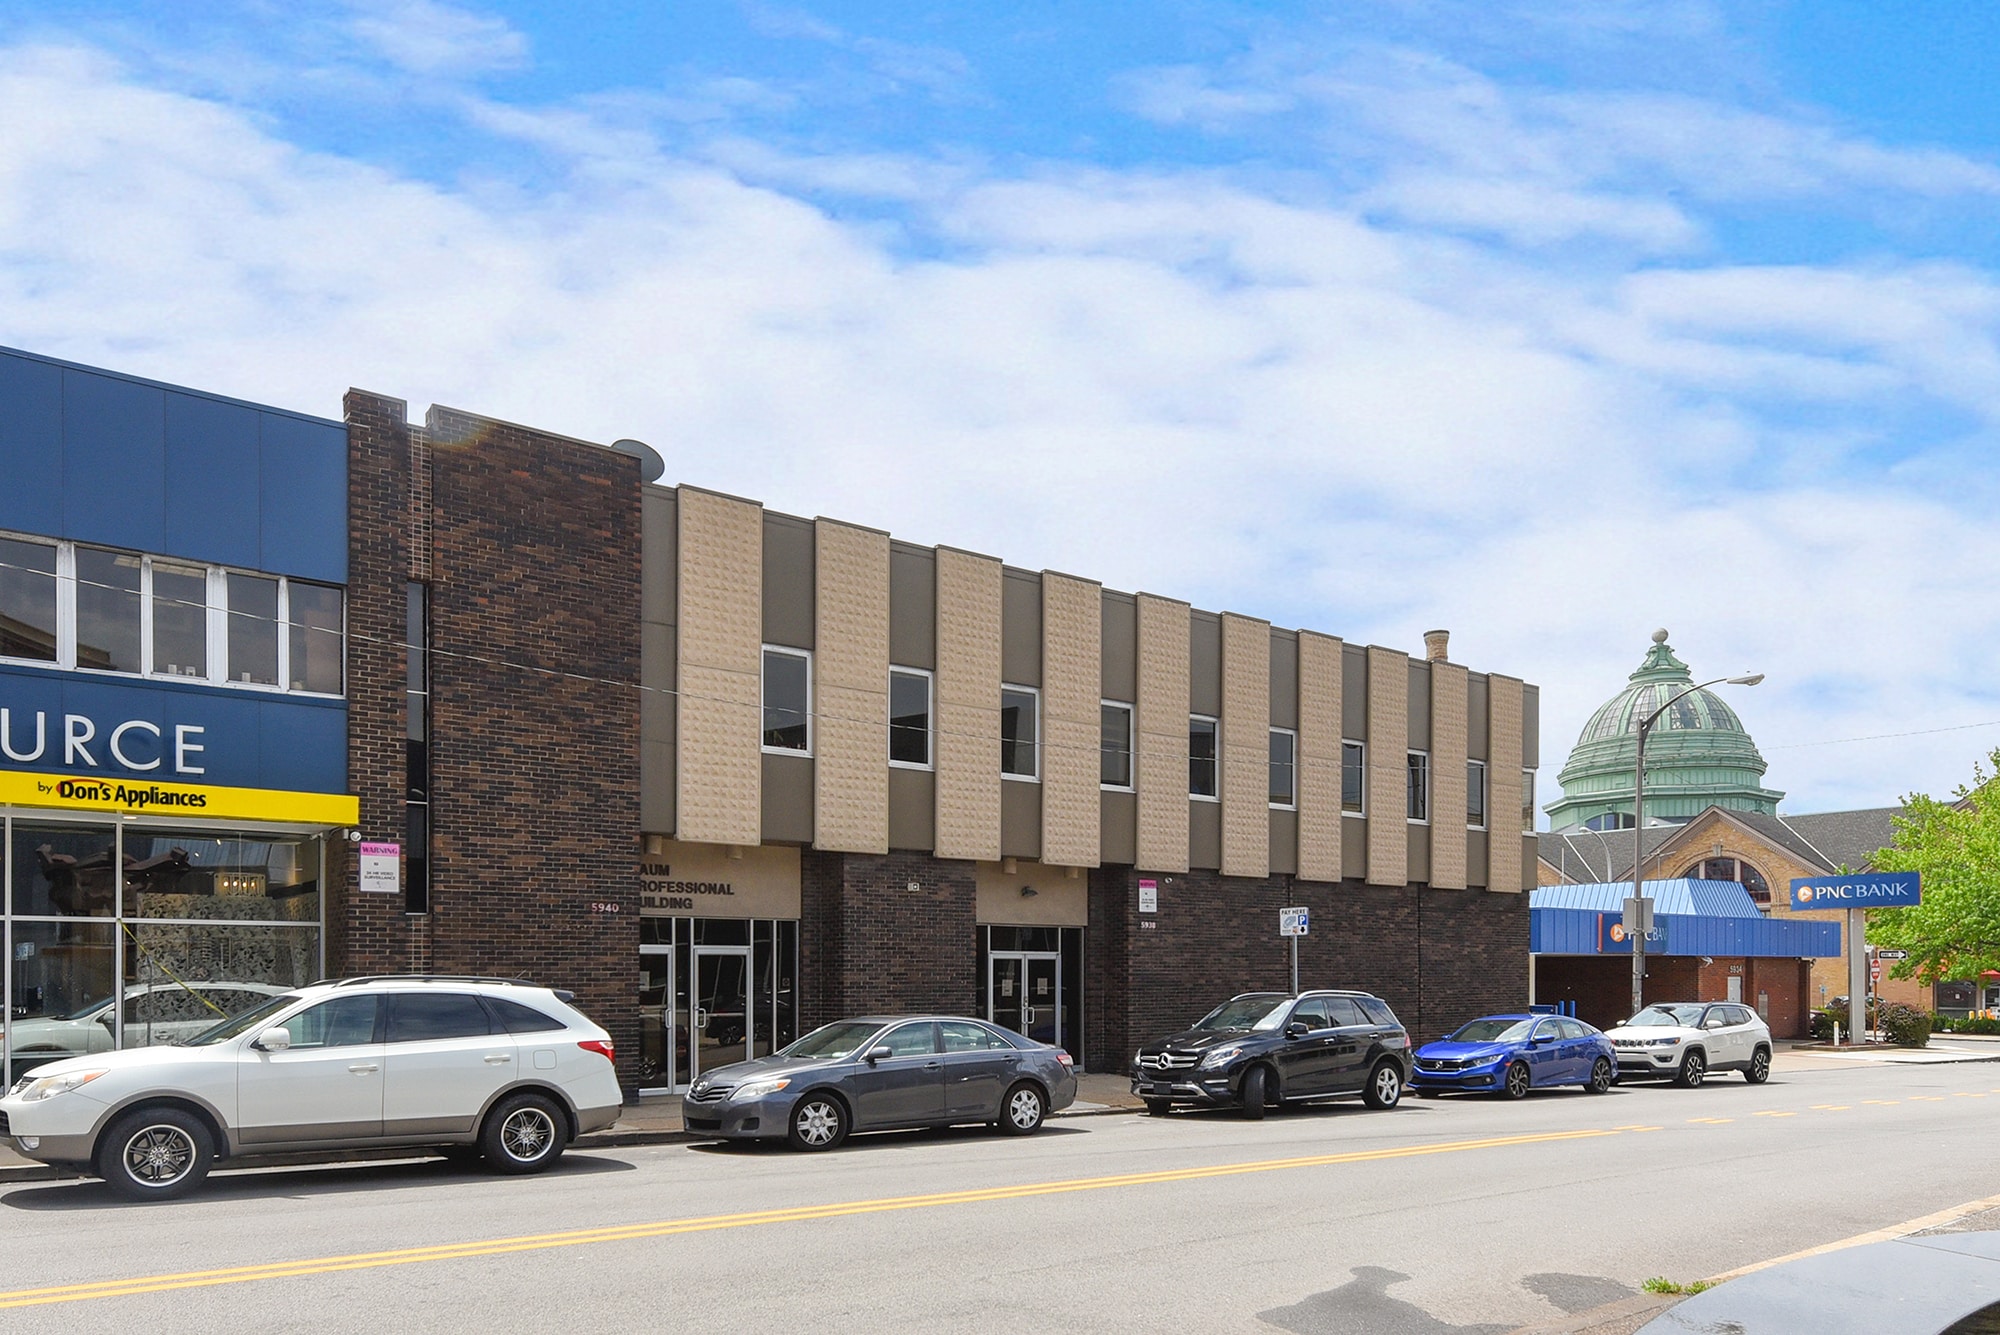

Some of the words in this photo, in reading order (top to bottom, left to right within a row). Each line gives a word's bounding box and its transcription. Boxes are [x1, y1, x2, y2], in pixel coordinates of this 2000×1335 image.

[1, 708, 205, 775] URCE
[37, 781, 53, 794] by
[60, 780, 111, 800] Don's
[115, 784, 207, 808] Appliances
[362, 846, 397, 854] WARNING
[1815, 885, 1852, 900] PNC
[1855, 882, 1909, 898] BANK
[591, 902, 619, 913] 5940
[1299, 915, 1306, 925] P
